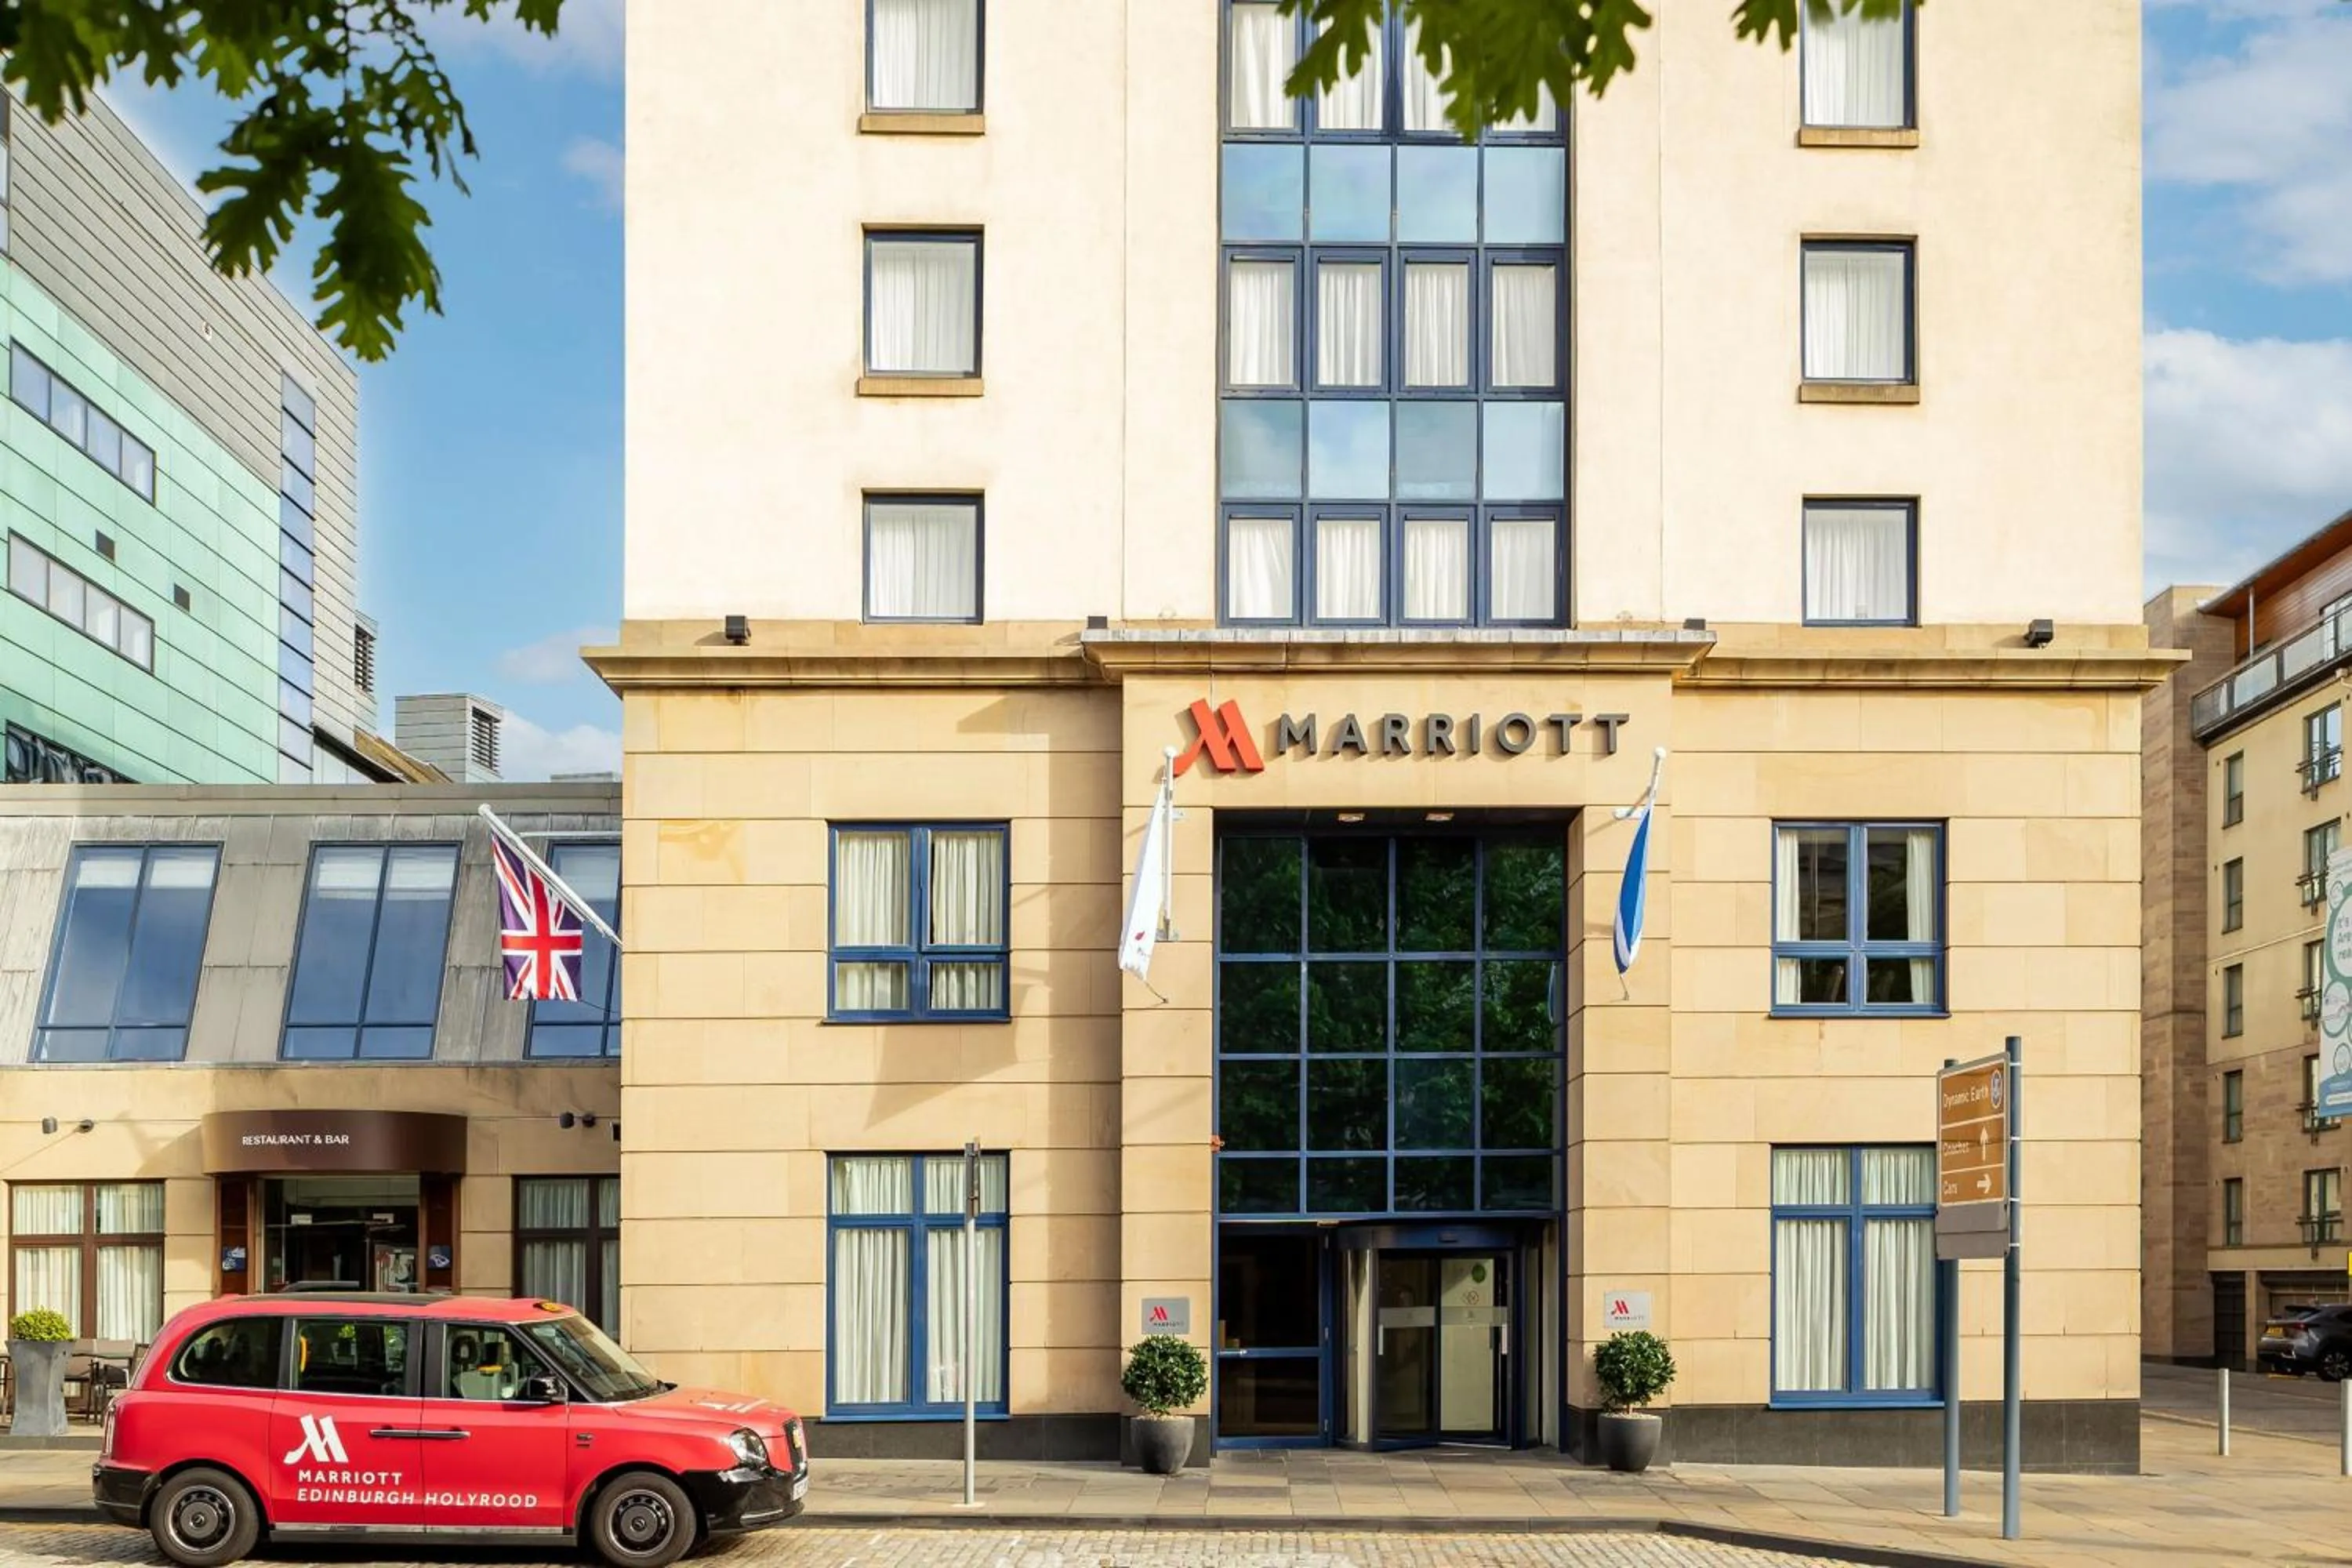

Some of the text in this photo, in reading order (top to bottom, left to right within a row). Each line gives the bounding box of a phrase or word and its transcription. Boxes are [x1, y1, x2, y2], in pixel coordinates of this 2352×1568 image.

[1278, 712, 1630, 756] MARRIOTT
[242, 1134, 349, 1145] RESTAURANT & BAR
[299, 1470, 401, 1485] MARRIOTT
[297, 1489, 538, 1508] EDINBURGH HOLYROOD
